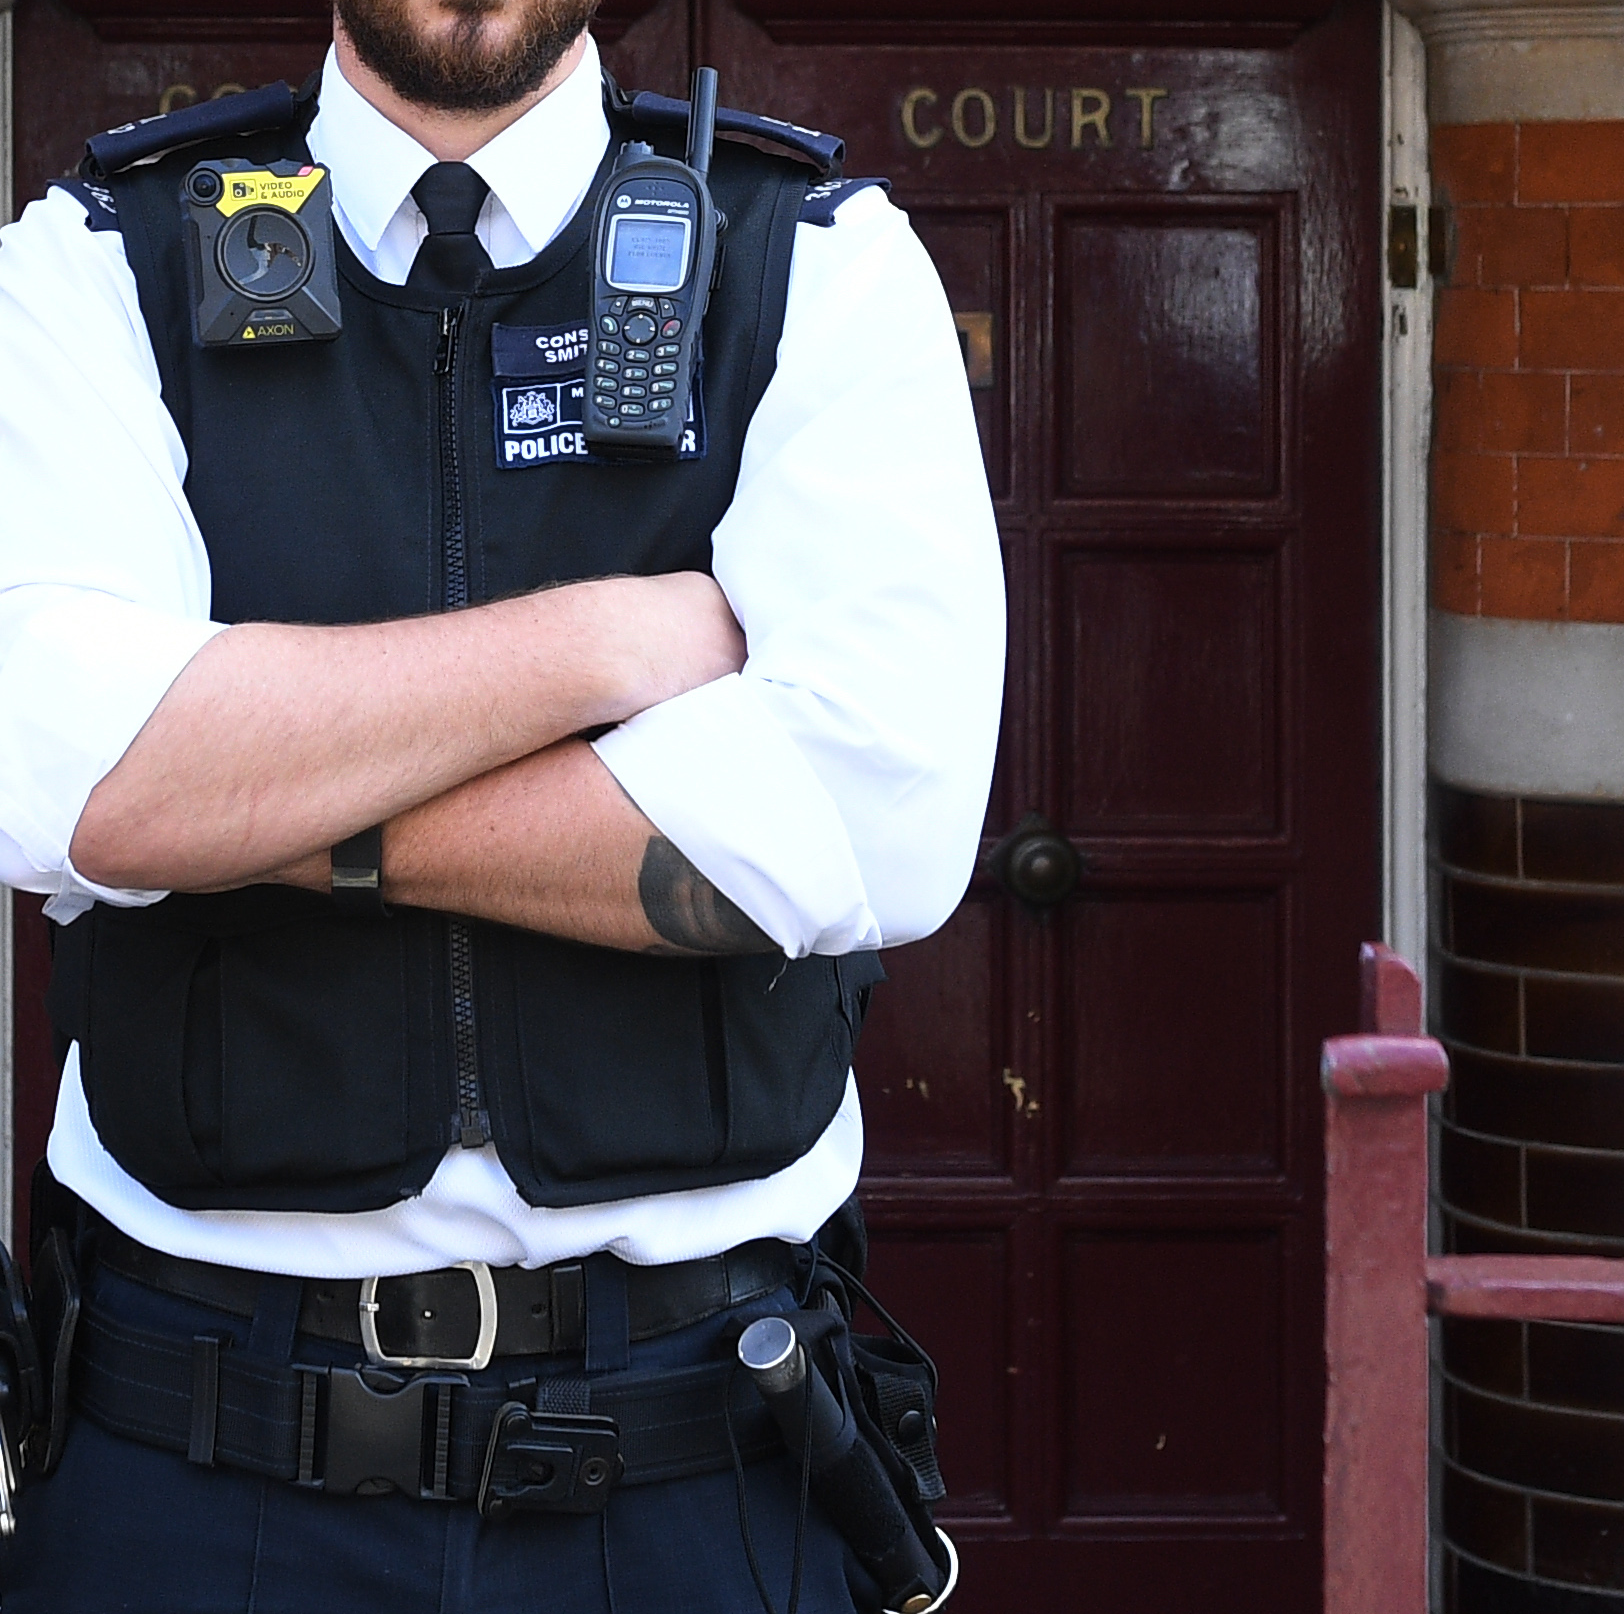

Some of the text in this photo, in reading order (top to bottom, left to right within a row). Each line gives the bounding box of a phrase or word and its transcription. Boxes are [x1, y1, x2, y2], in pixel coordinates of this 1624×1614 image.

[900, 87, 1170, 149] COURT
[260, 181, 292, 191] VIDEO
[261, 189, 305, 199] & AUDIO
[635, 199, 690, 208] MOTOROLA
[631, 300, 654, 308] MENU
[257, 324, 294, 336] AXON
[536, 328, 589, 349] CONS
[545, 344, 589, 363] SMIT
[505, 432, 588, 461] POLICE
